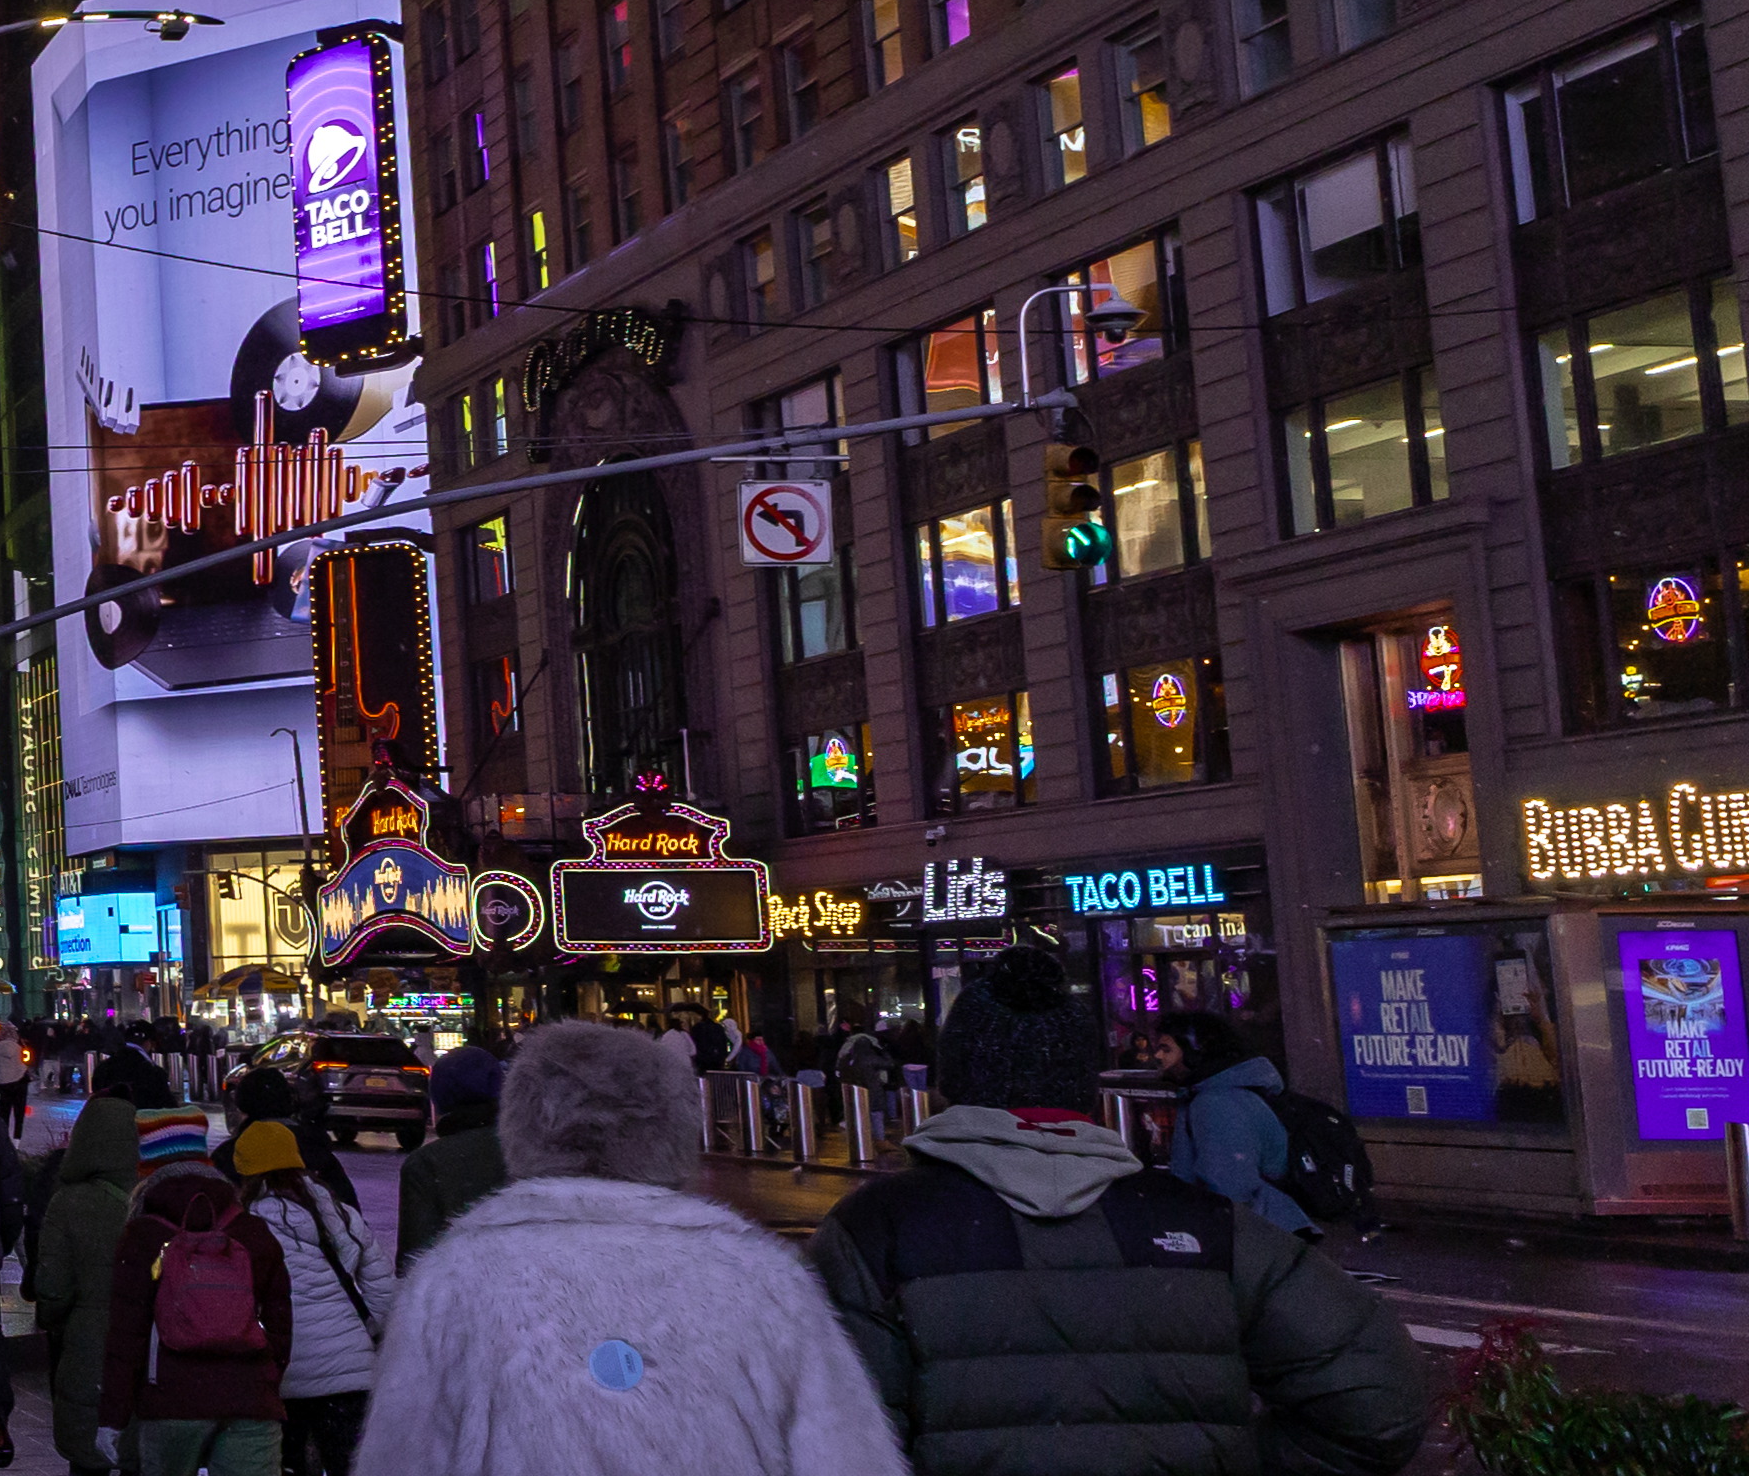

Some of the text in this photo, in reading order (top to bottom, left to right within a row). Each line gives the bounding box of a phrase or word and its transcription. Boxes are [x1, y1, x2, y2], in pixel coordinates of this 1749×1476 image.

[131, 116, 293, 177] Everything
[103, 173, 294, 245] you imagine
[304, 189, 371, 225] TACO
[311, 212, 371, 249] BELL
[606, 833, 699, 855] Hard Rock
[1522, 797, 1667, 882] BUBBA
[59, 870, 84, 895] AT&T
[623, 888, 690, 907] Hard Rock
[1064, 864, 1225, 913] TACO BELL
[813, 891, 861, 935] Shop
[1379, 969, 1425, 1001] MAKE
[1379, 1001, 1436, 1034] RETAIL
[1665, 1019, 1709, 1042] MAKE
[1352, 1033, 1470, 1068] FUTURE-READY
[1664, 1040, 1715, 1060] RETAIL
[1638, 1058, 1745, 1080] FUTURE-READY
